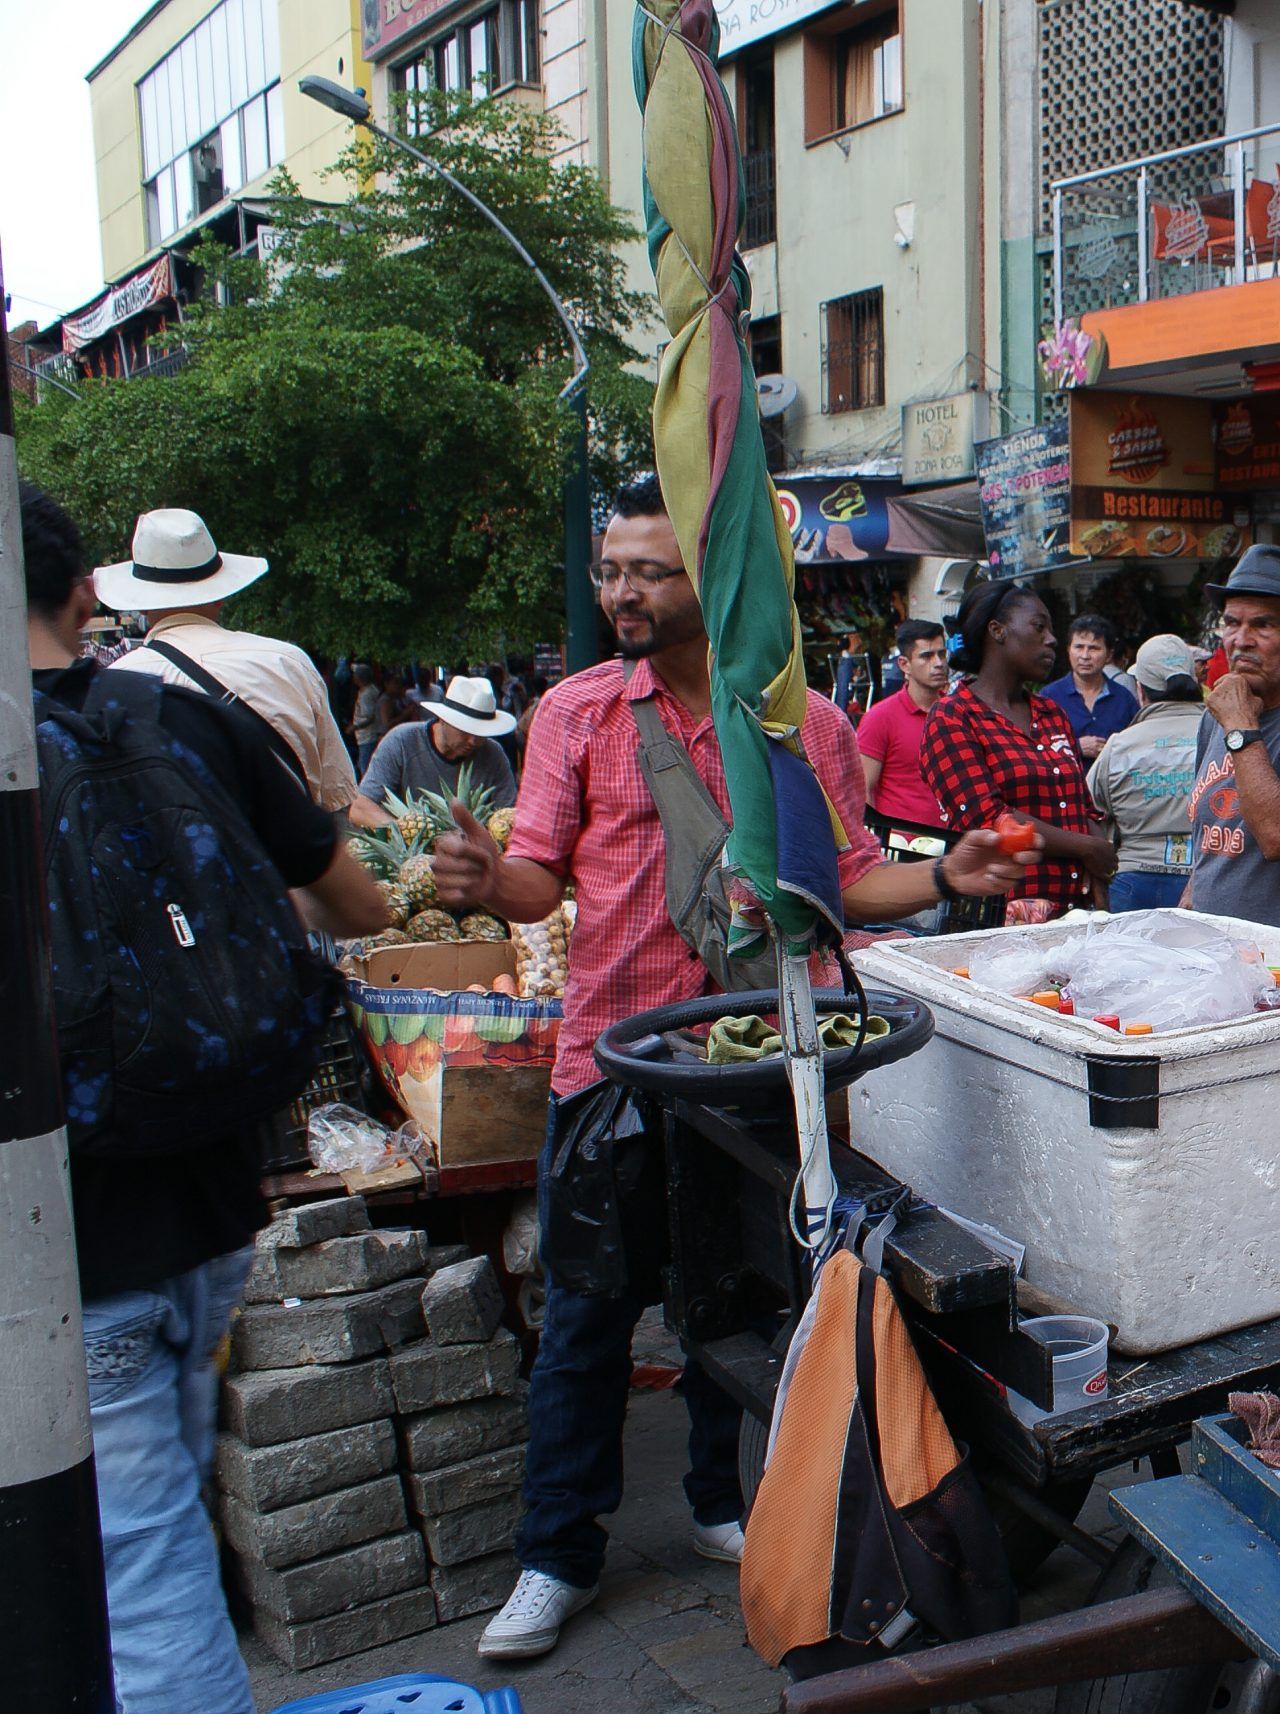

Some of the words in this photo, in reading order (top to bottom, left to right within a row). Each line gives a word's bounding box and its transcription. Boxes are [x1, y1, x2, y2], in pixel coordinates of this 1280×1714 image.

[916, 404, 958, 424] HOTEL
[1002, 433, 1047, 456] TIENDA
[1103, 490, 1223, 518] Restaurante
